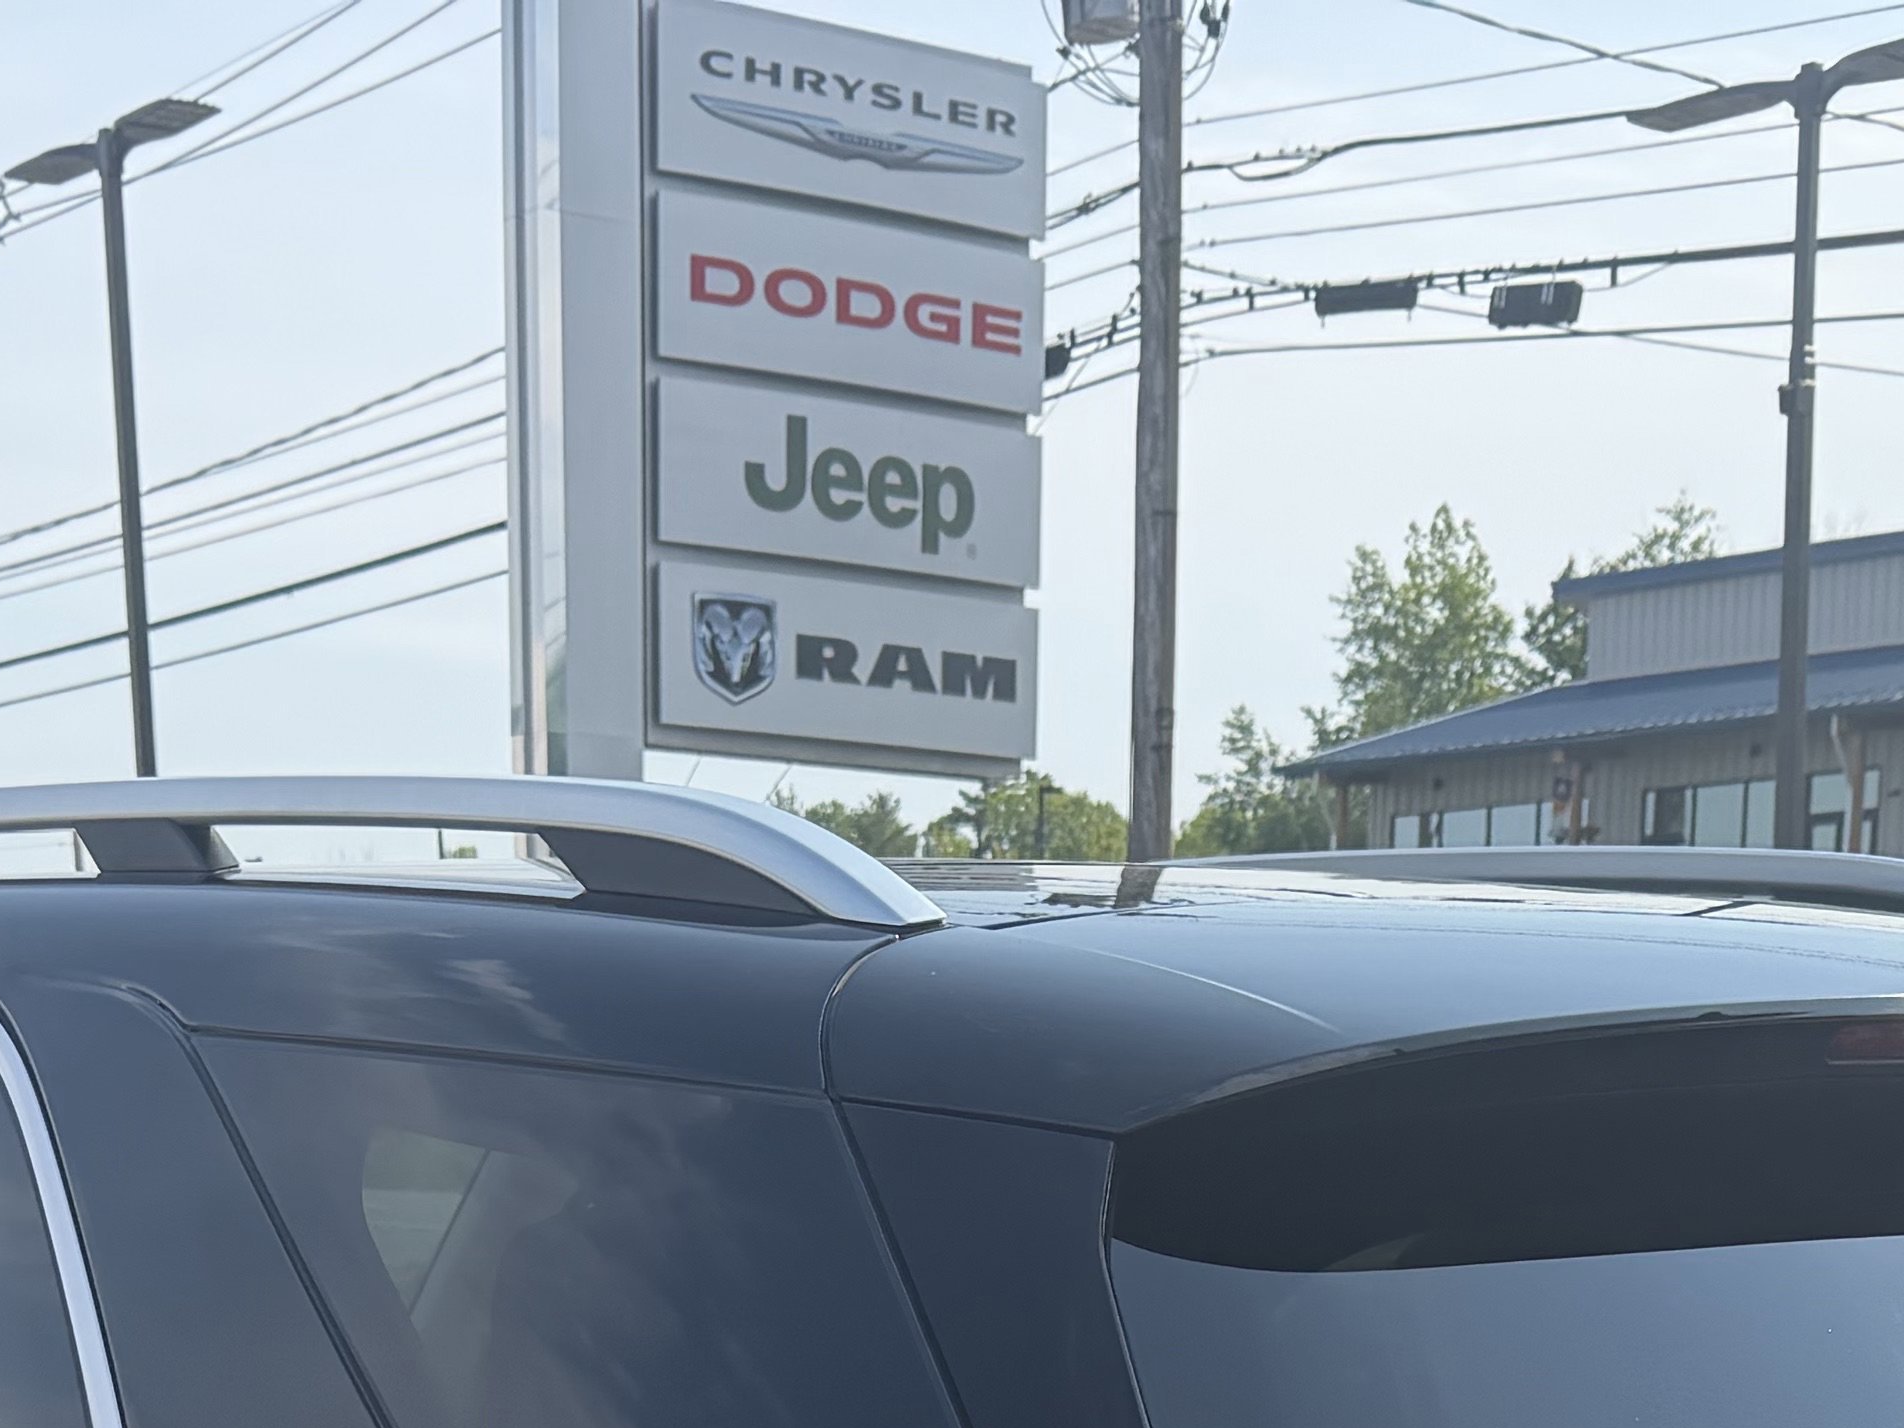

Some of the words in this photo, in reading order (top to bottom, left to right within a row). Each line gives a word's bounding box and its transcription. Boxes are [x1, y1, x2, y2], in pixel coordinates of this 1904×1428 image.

[699, 48, 1017, 138] CHRYSLER
[690, 253, 1023, 356] DODGE
[744, 413, 976, 556] Jeep
[796, 633, 1017, 704] RAM
